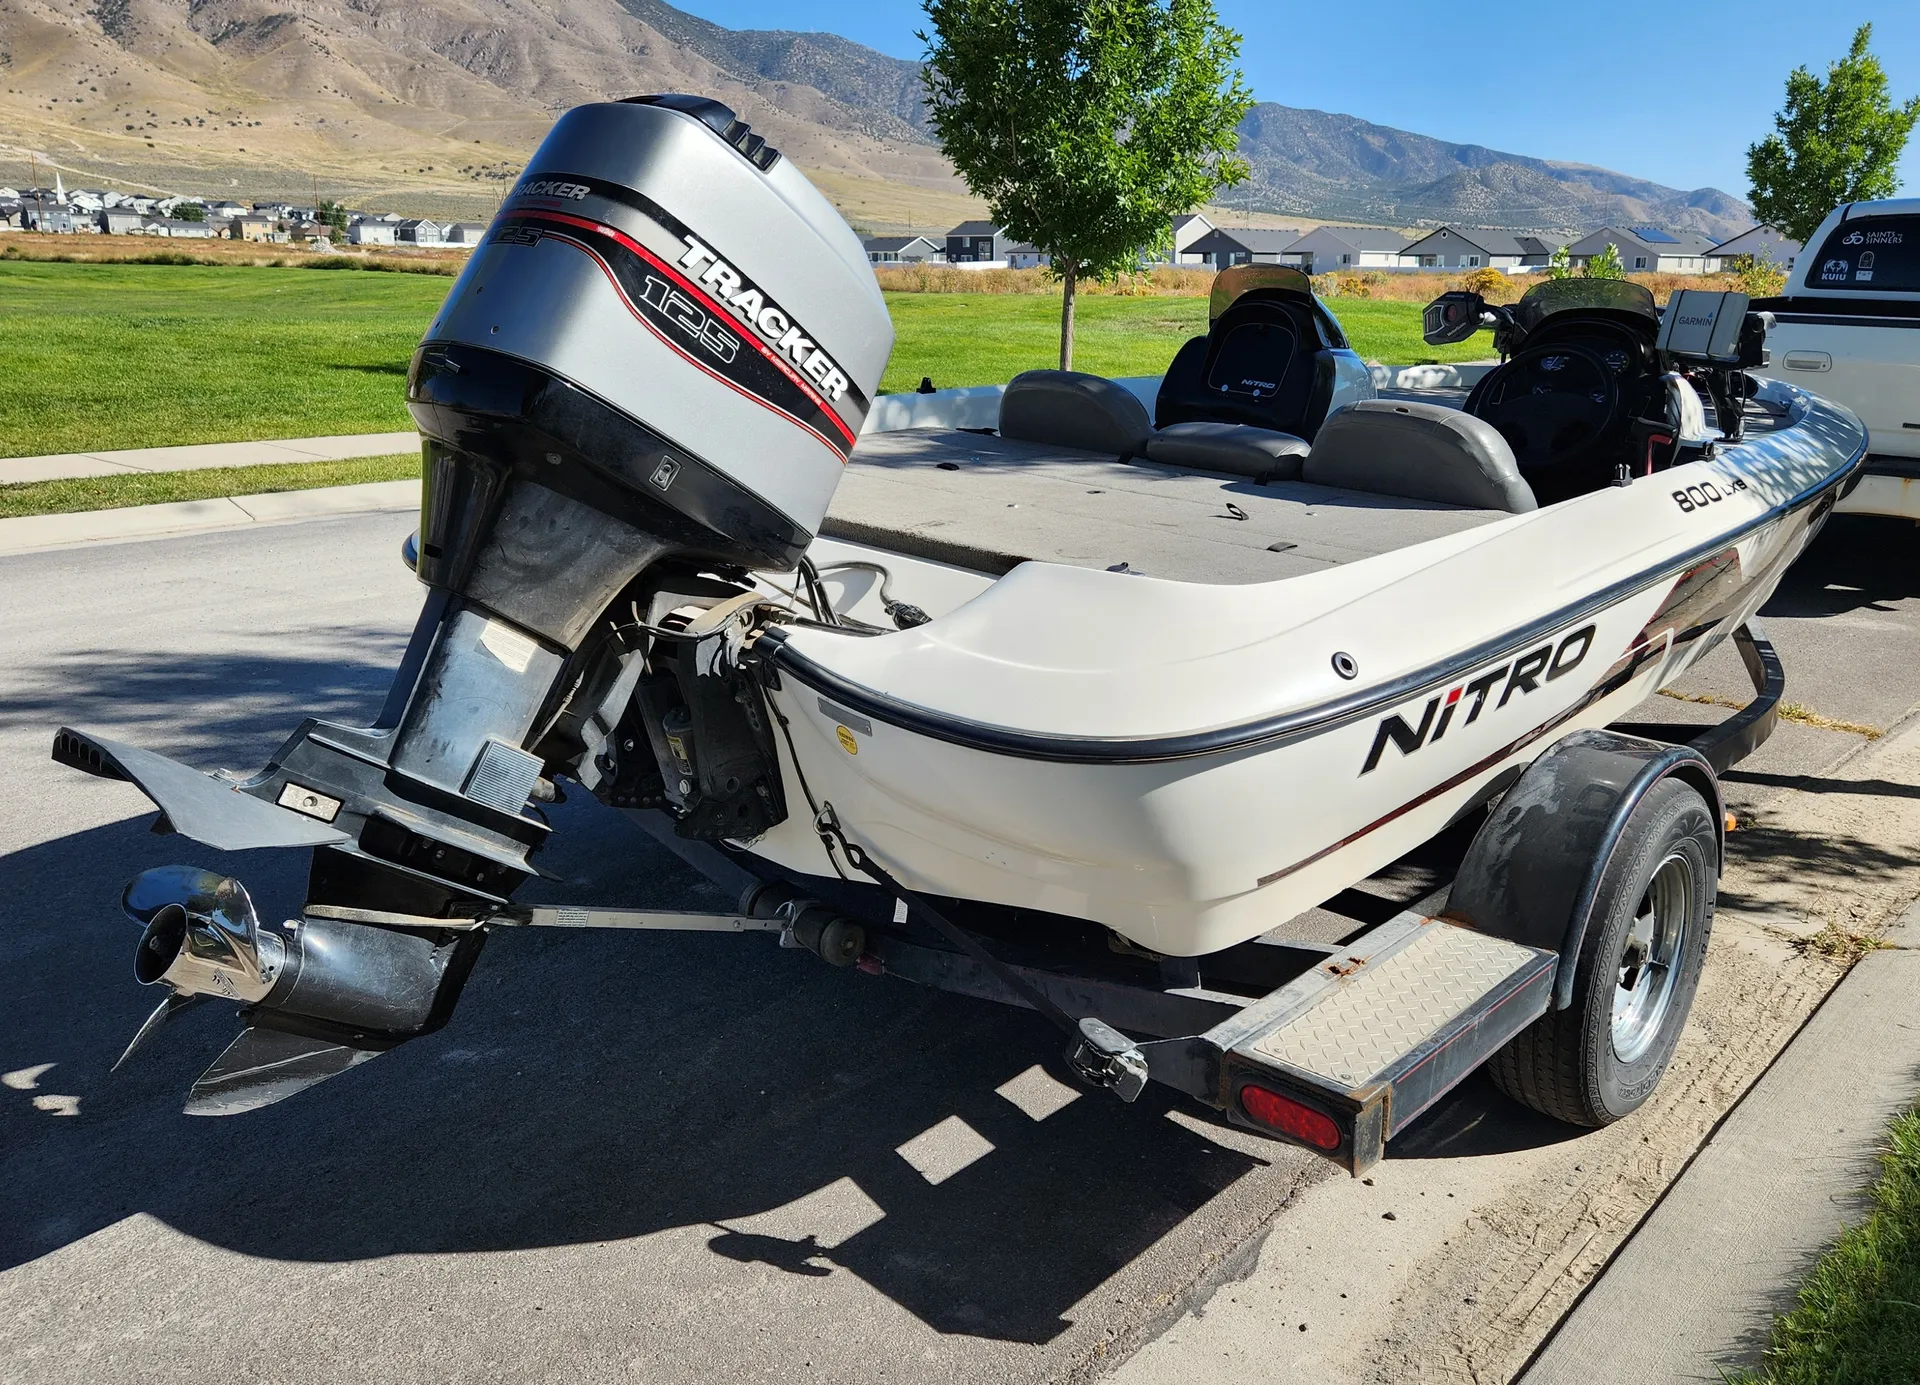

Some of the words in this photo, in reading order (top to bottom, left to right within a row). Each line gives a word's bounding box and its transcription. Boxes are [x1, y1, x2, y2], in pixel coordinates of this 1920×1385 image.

[1865, 236, 1903, 244] SINNERS
[1821, 273, 1847, 281] KUIU
[639, 274, 741, 365] 125
[677, 235, 849, 402] TRACKER
[1678, 316, 1713, 327] GARMIN
[1241, 378, 1276, 389] NITRO
[1671, 481, 1723, 513] 800
[1357, 622, 1598, 779] NITRO
